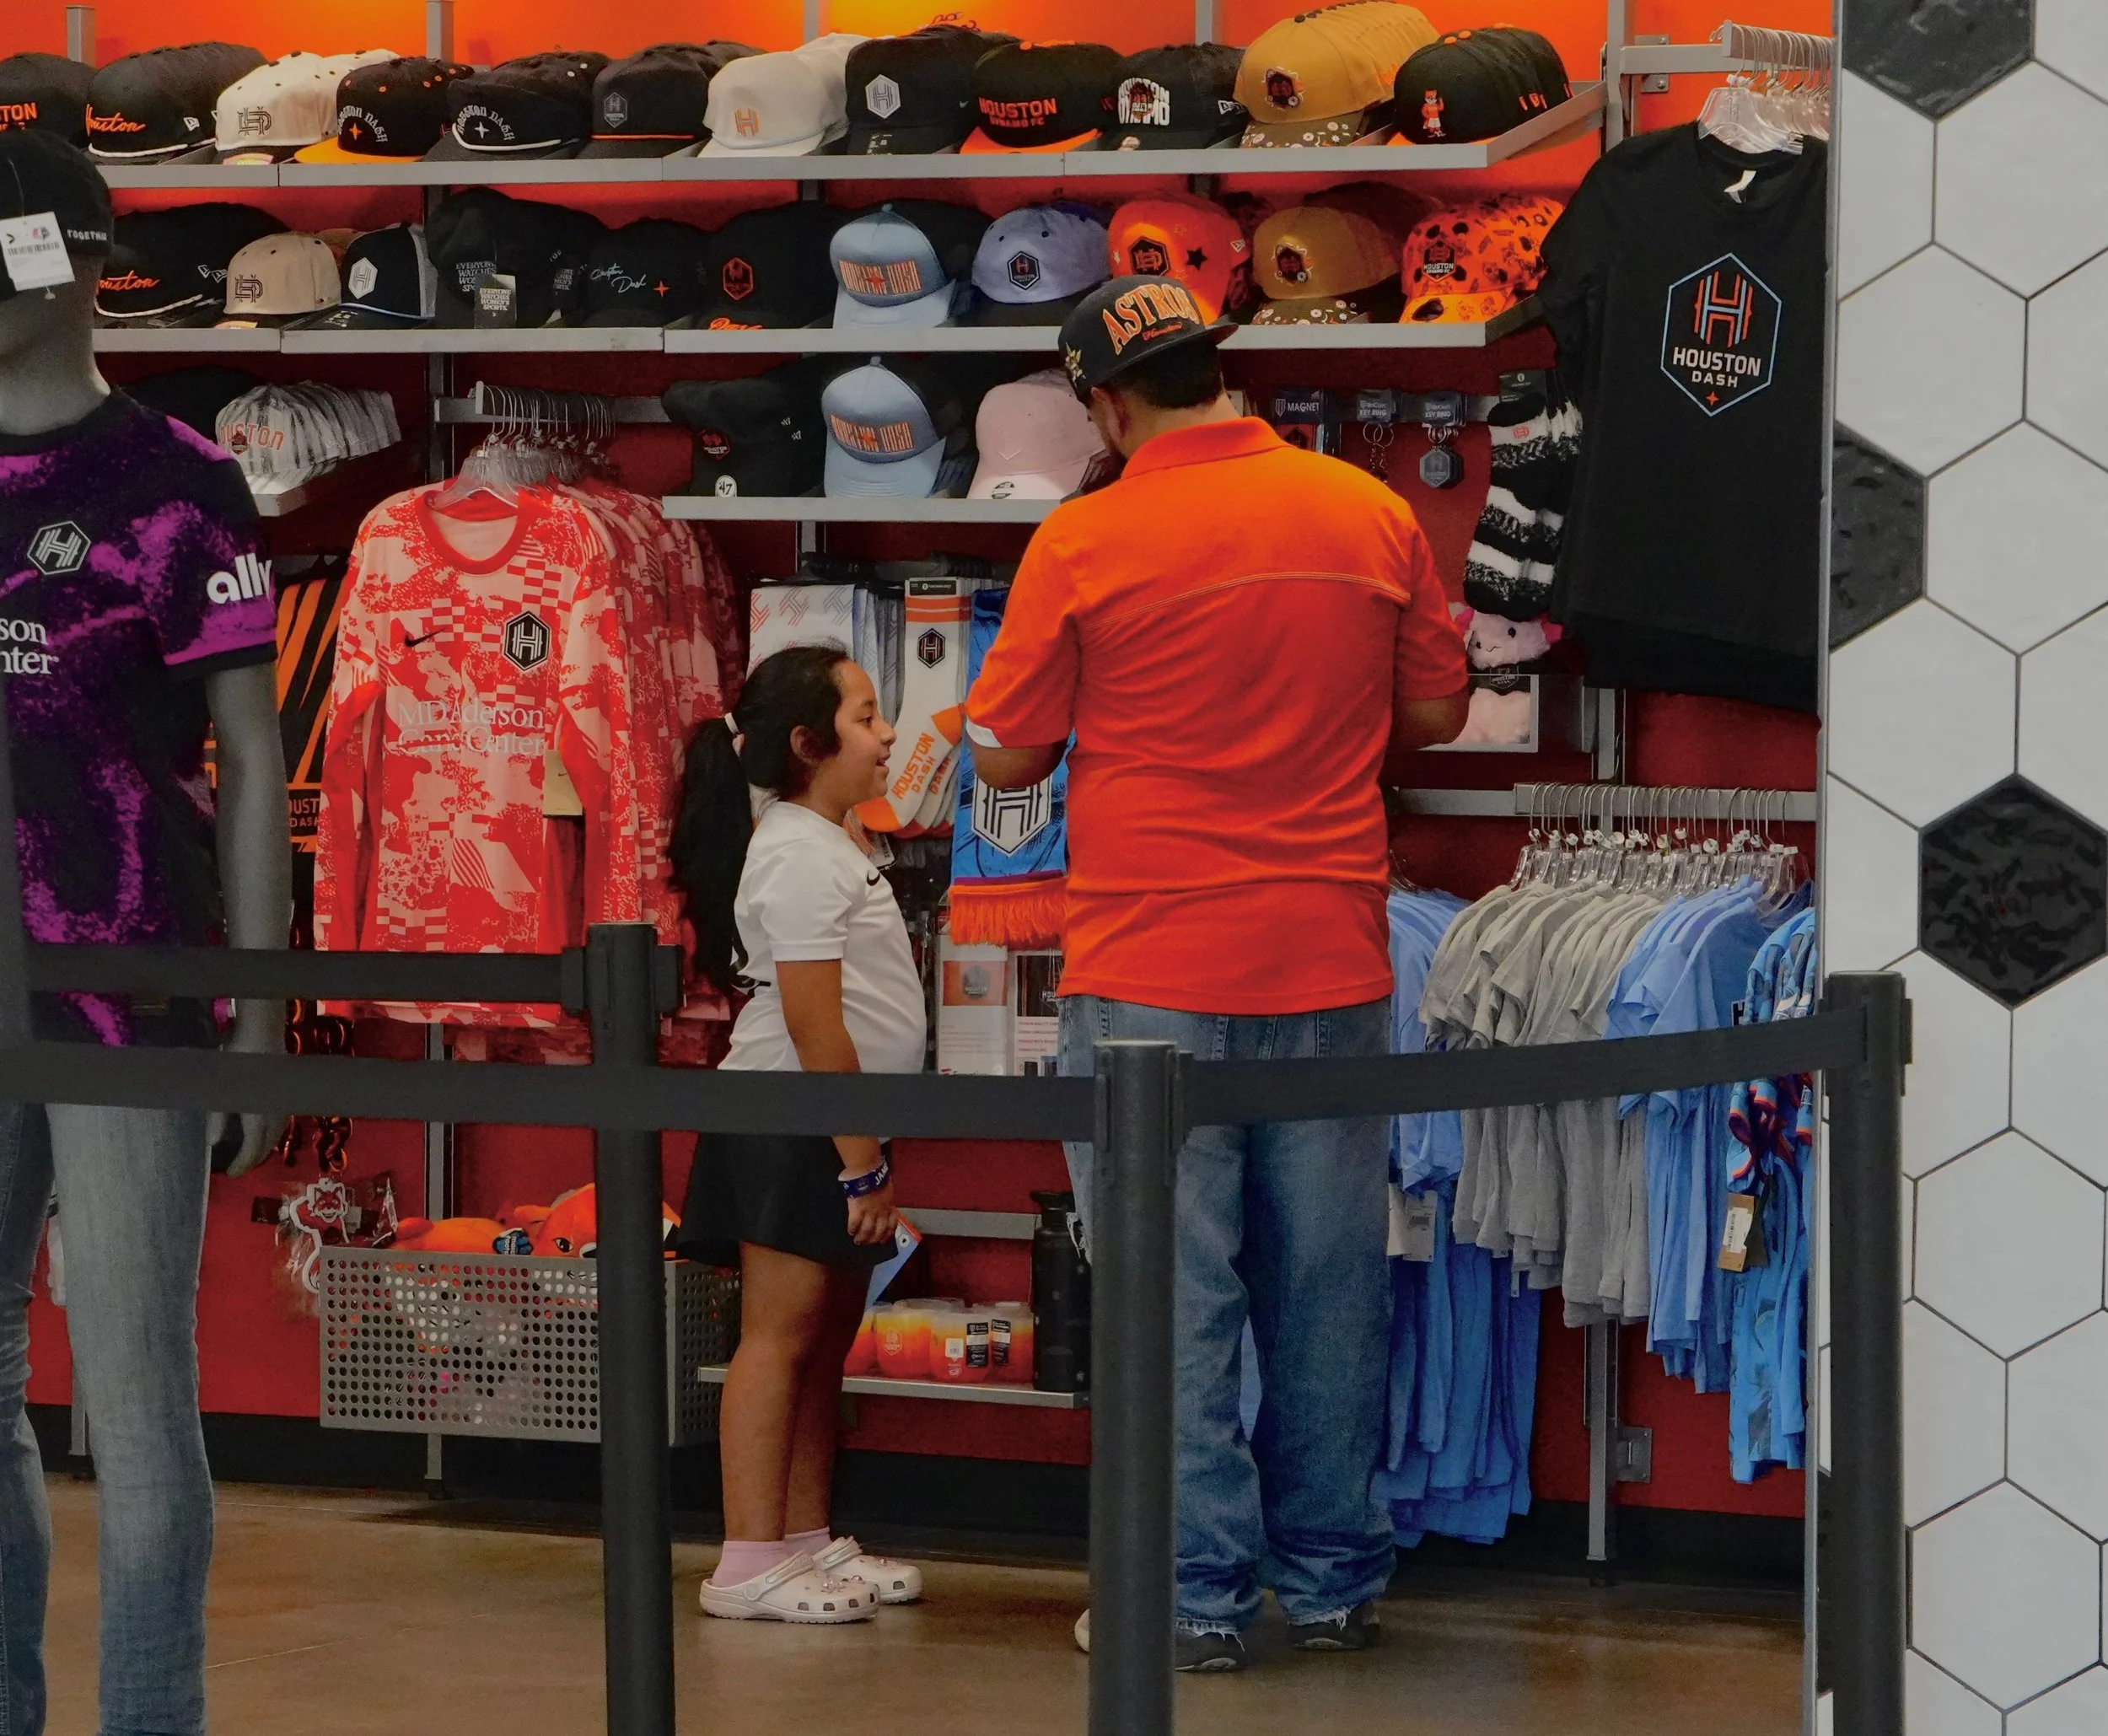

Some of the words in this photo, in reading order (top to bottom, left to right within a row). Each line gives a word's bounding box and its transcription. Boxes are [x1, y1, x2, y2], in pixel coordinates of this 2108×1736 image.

[86, 104, 146, 136] Houston
[979, 97, 1057, 116] HOUSTON
[1102, 283, 1199, 355] ASTROS
[1672, 347, 1761, 377] HOUSTON
[1691, 370, 1738, 388] DASH
[1287, 402, 1320, 412] MAGNET
[207, 552, 272, 605] ally
[398, 701, 447, 726] MD
[466, 726, 545, 756] Center
[891, 734, 934, 799] HOUSTON
[912, 756, 935, 793] DASH
